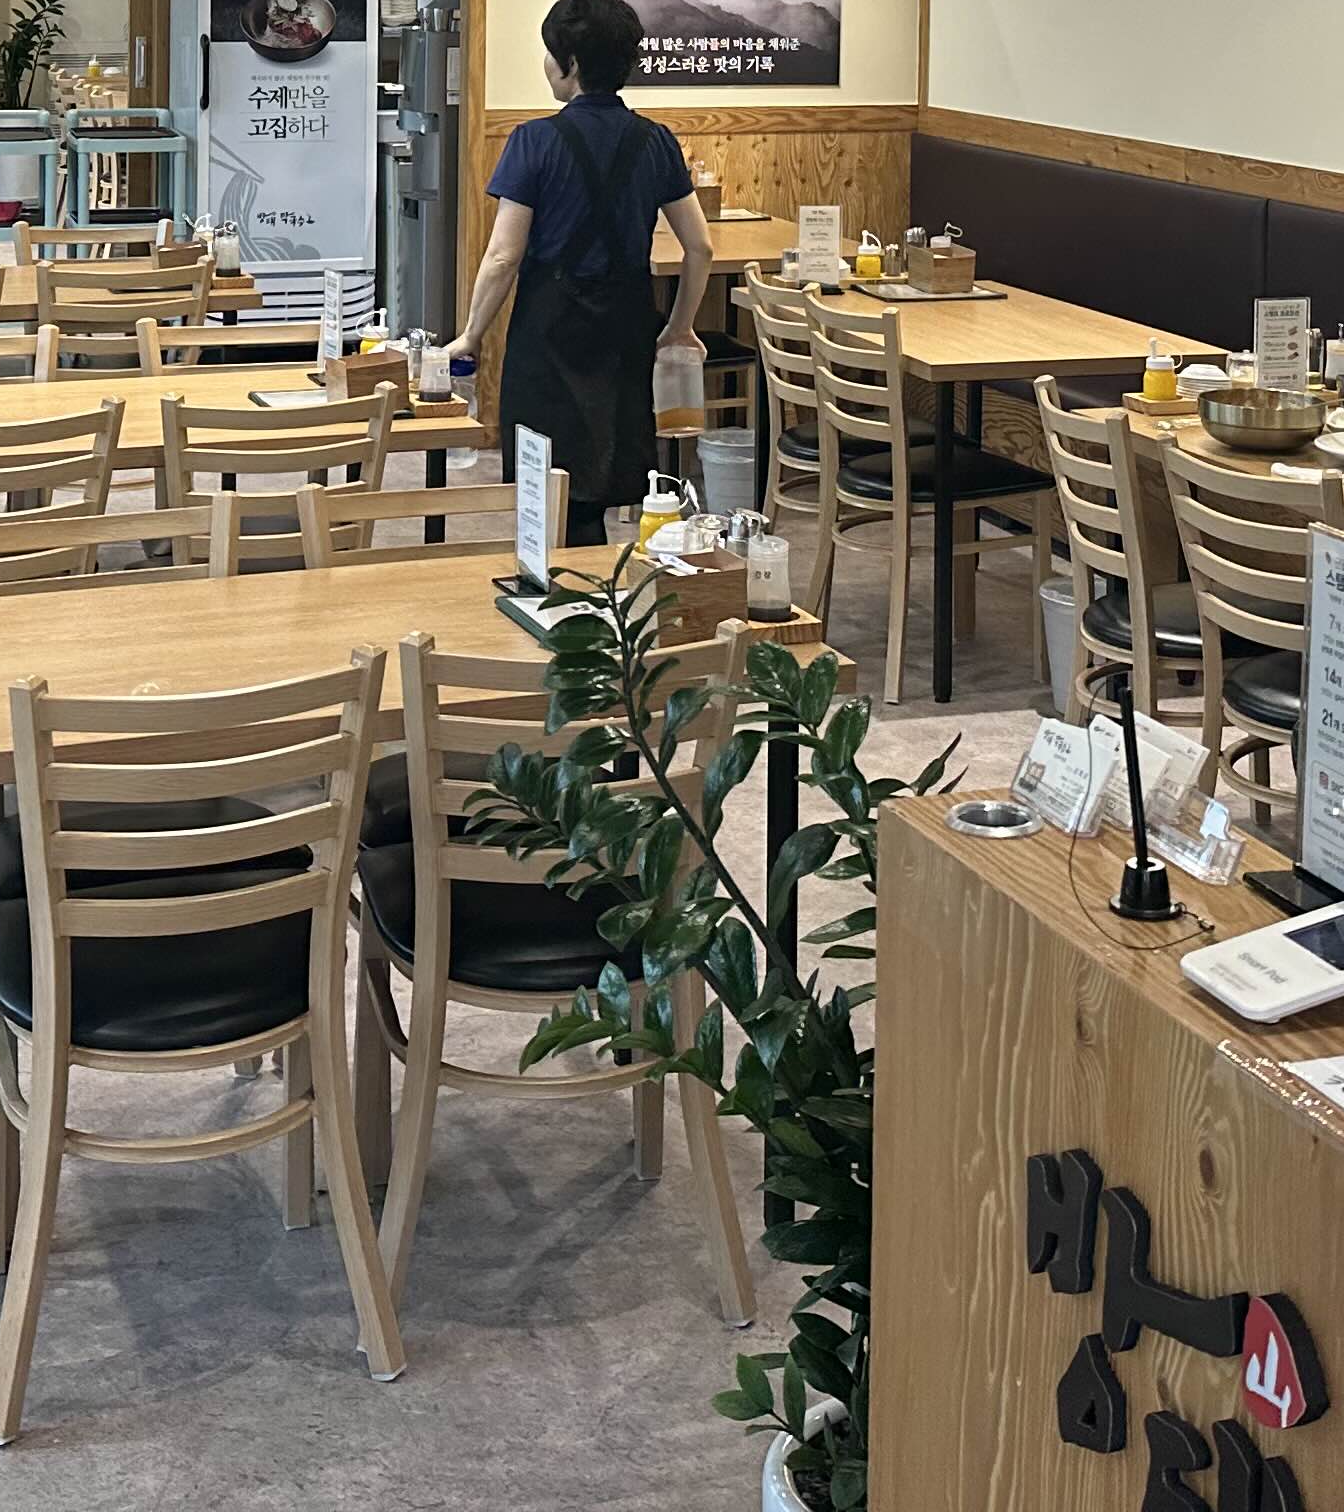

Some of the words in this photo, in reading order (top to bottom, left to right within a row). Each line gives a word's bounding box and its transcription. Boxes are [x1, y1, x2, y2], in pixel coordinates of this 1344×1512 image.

[638, 55, 710, 74] 정성스러운
[713, 55, 742, 74] 맛의
[745, 55, 775, 74] 기록
[247, 85, 330, 110] 수제만을
[247, 114, 330, 140] 고집하다
